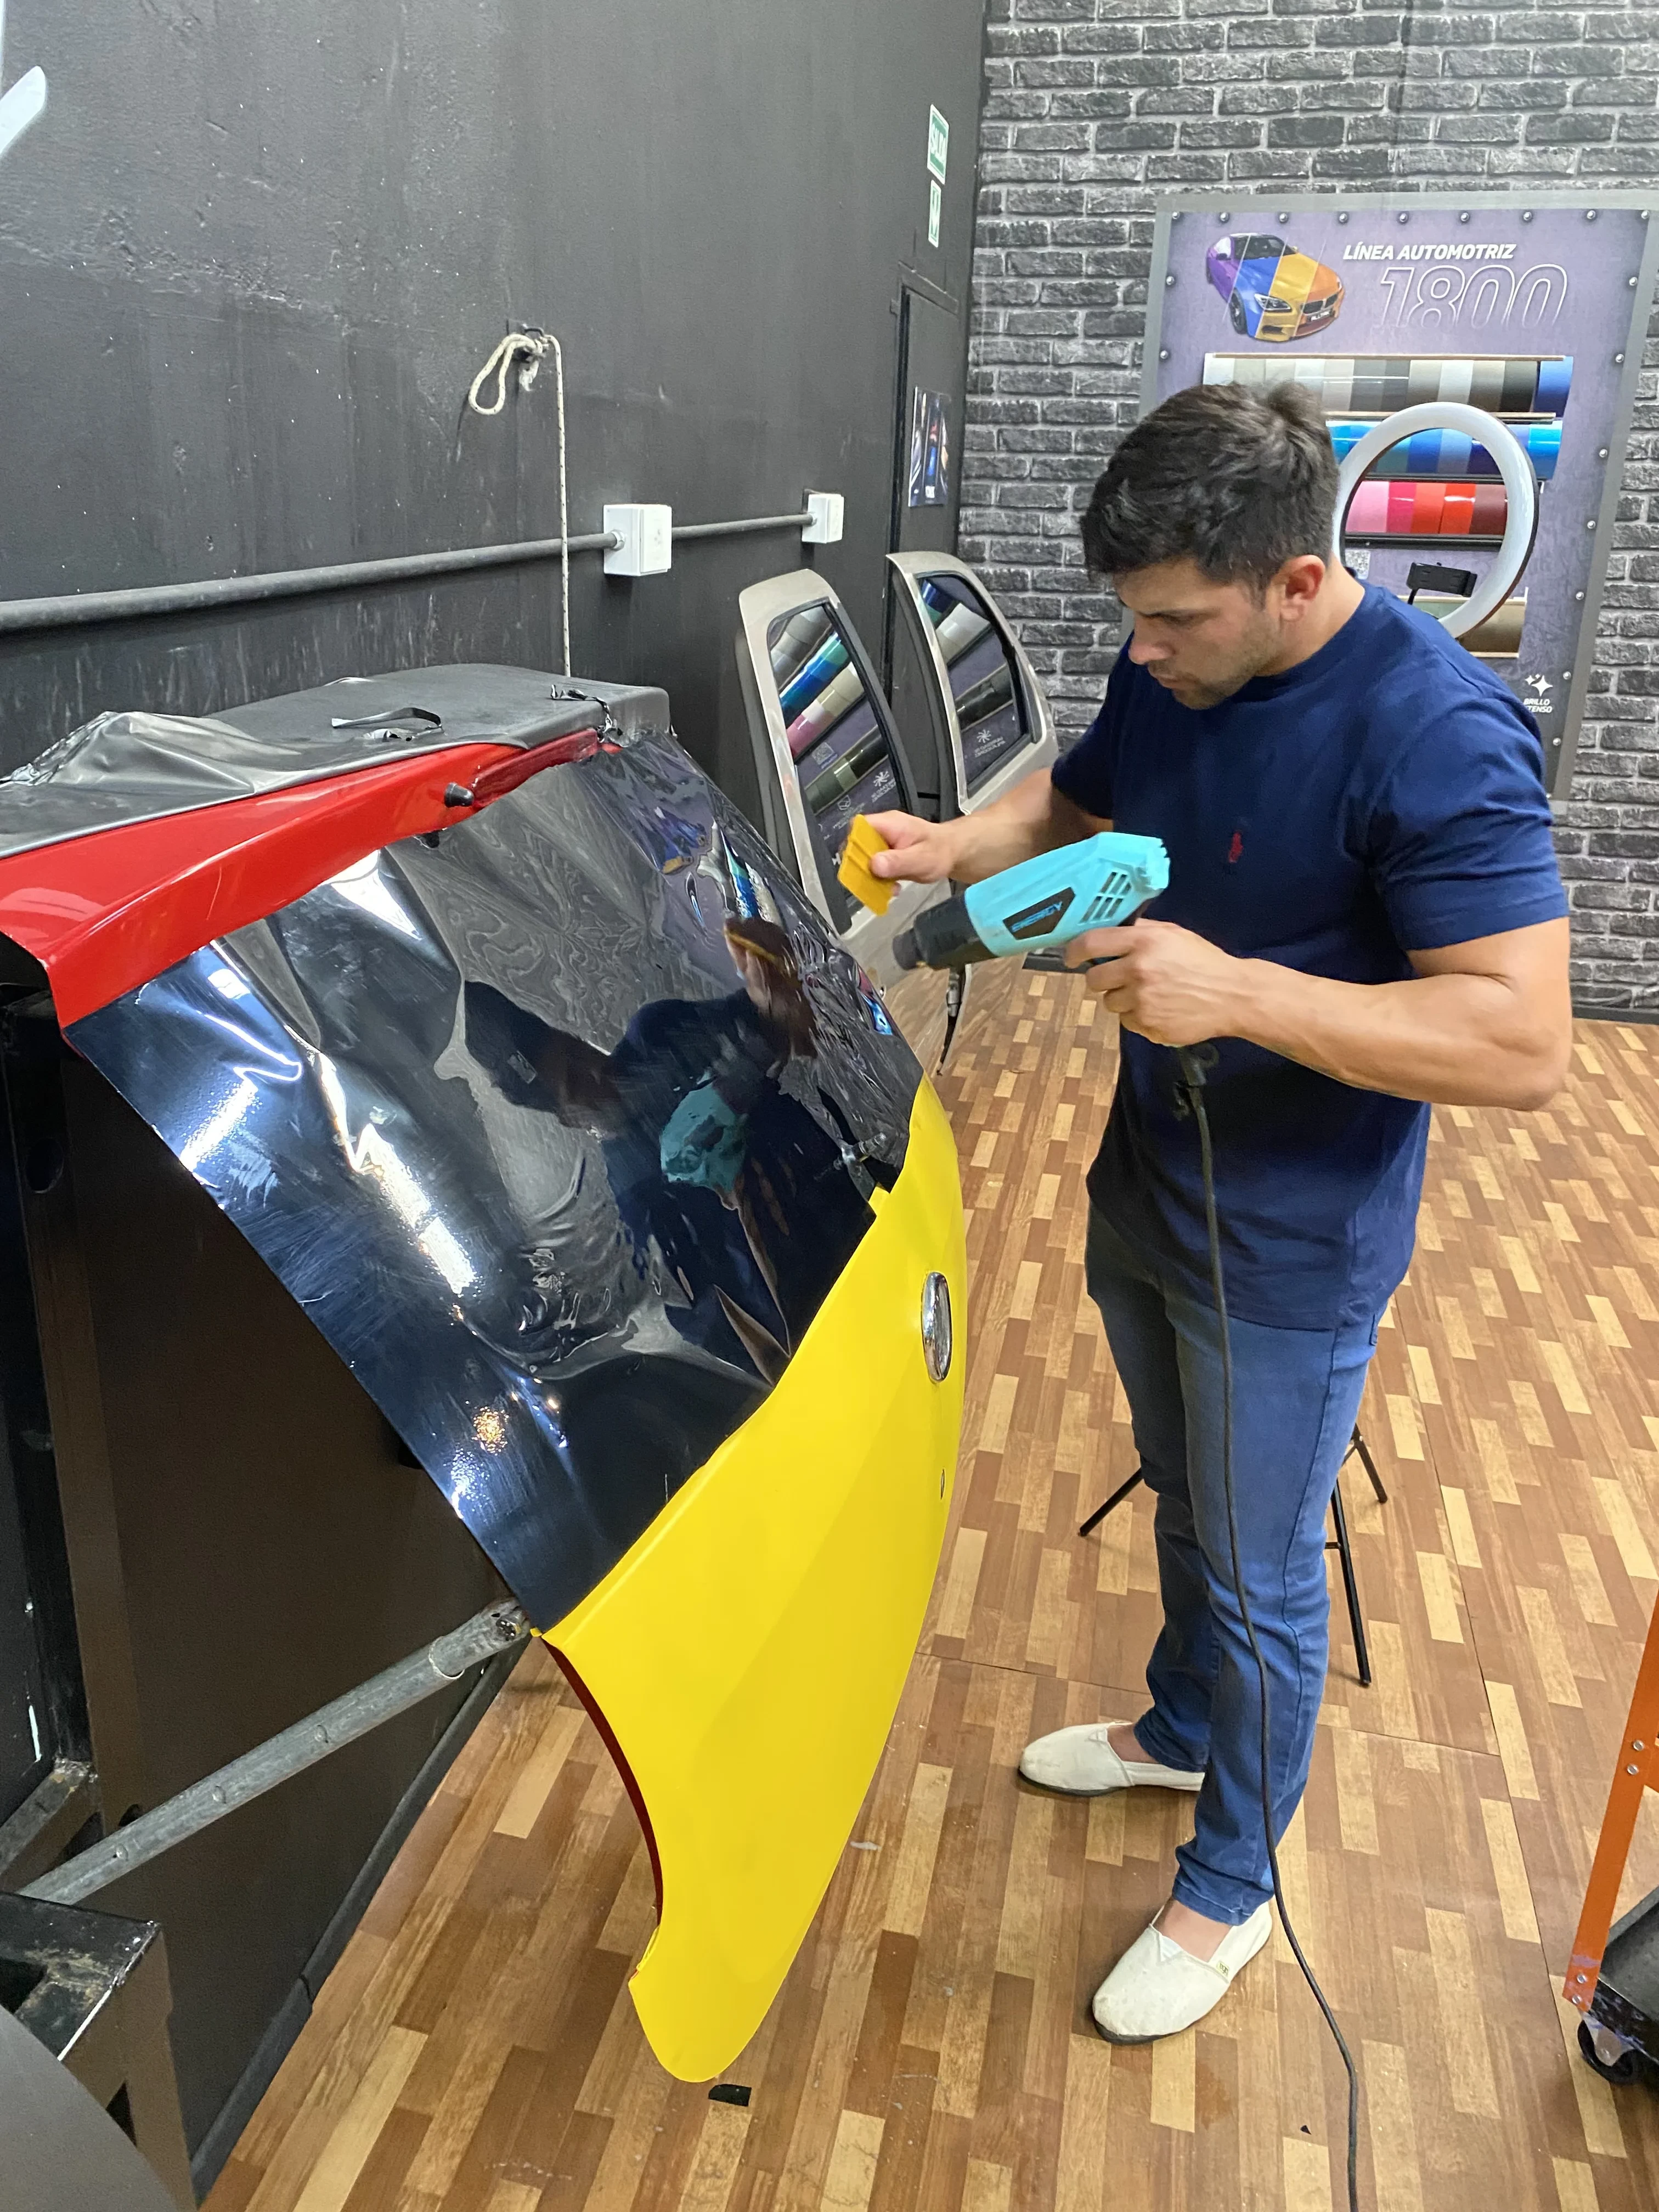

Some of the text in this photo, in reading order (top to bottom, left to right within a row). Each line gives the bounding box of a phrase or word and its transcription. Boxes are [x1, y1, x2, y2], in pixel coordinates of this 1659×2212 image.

[1343, 241, 1516, 260] LÍNEA AUTOMOTRIZ
[1380, 264, 1567, 328] 1800
[1523, 698, 1550, 706] BRILLO
